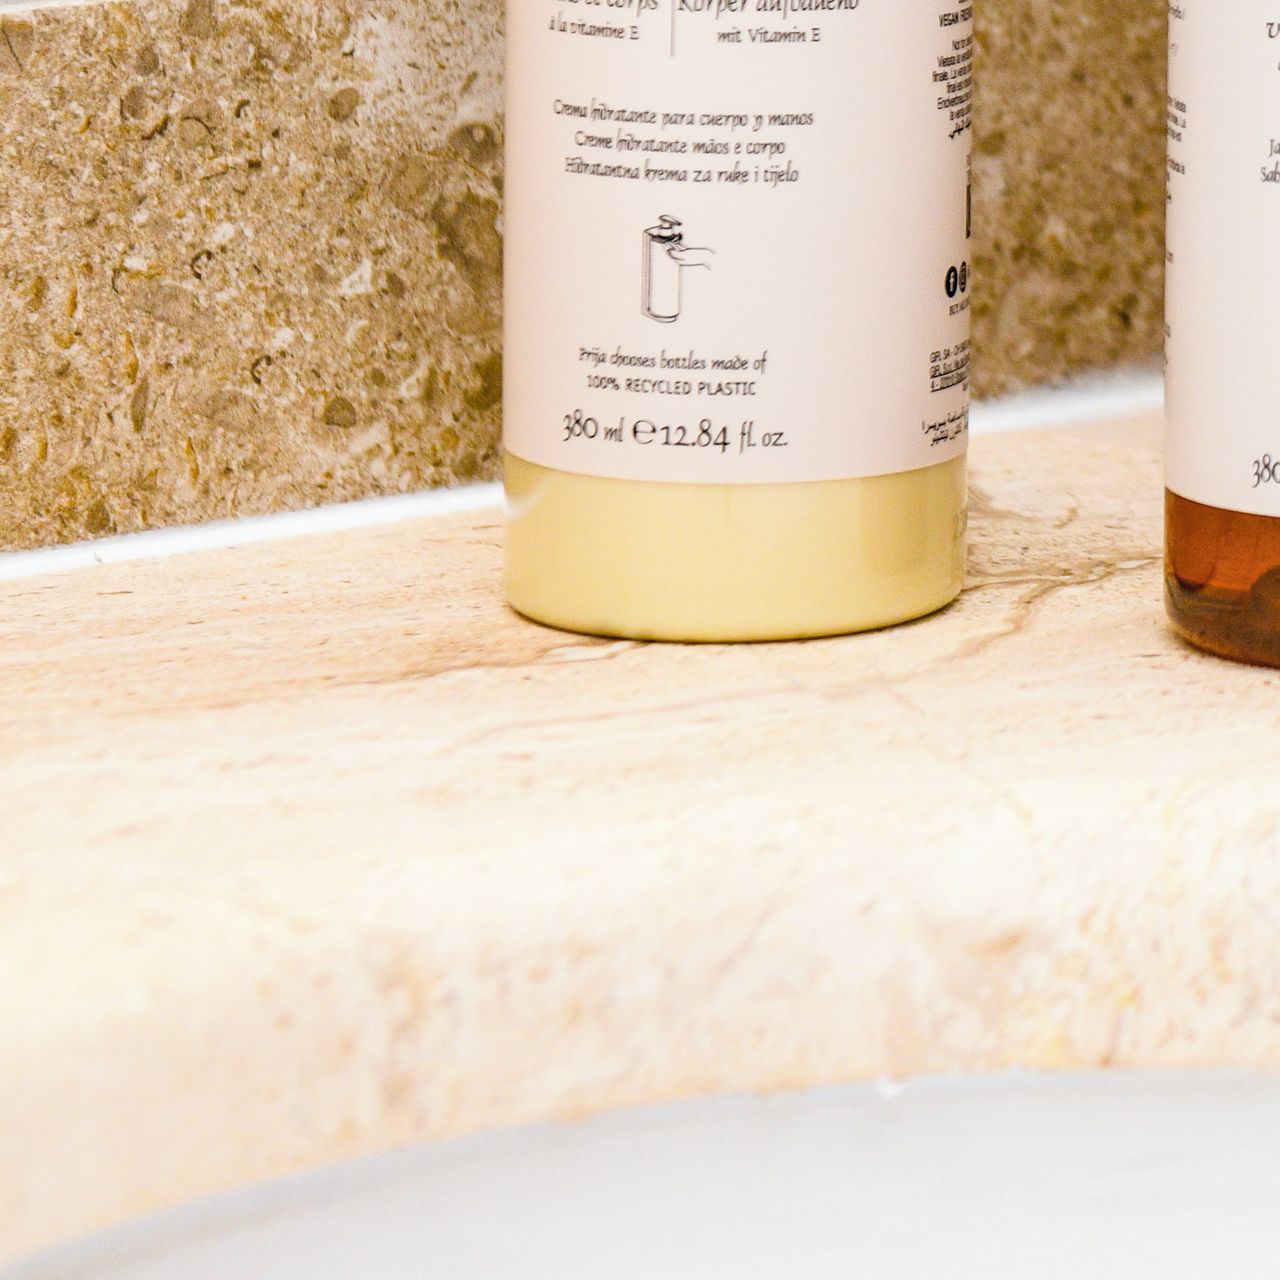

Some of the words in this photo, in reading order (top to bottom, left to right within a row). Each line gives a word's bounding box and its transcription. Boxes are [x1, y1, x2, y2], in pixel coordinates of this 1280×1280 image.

[629, 26, 639, 40] E
[717, 27, 742, 43] mit
[747, 26, 806, 43] Vitamin
[811, 28, 820, 42] E
[553, 99, 588, 118] Crema
[662, 113, 695, 129] para
[699, 114, 749, 131] cuerpo
[768, 113, 813, 126] manos
[575, 131, 613, 149] Creme
[734, 142, 742, 154] e
[746, 142, 786, 160] corpo
[644, 158, 688, 182] krema
[693, 170, 712, 182] za
[717, 161, 749, 184] ruke
[764, 159, 799, 188] tijelo
[609, 346, 656, 368] chooses
[660, 349, 706, 370] bottles
[711, 355, 749, 370] made
[753, 350, 767, 374] of
[587, 375, 620, 390] 100%
[625, 378, 692, 395] RECYCLED
[698, 381, 756, 396] PLASTIC
[563, 409, 599, 441] 380
[604, 417, 624, 442] ml
[659, 418, 731, 453] 12.84
